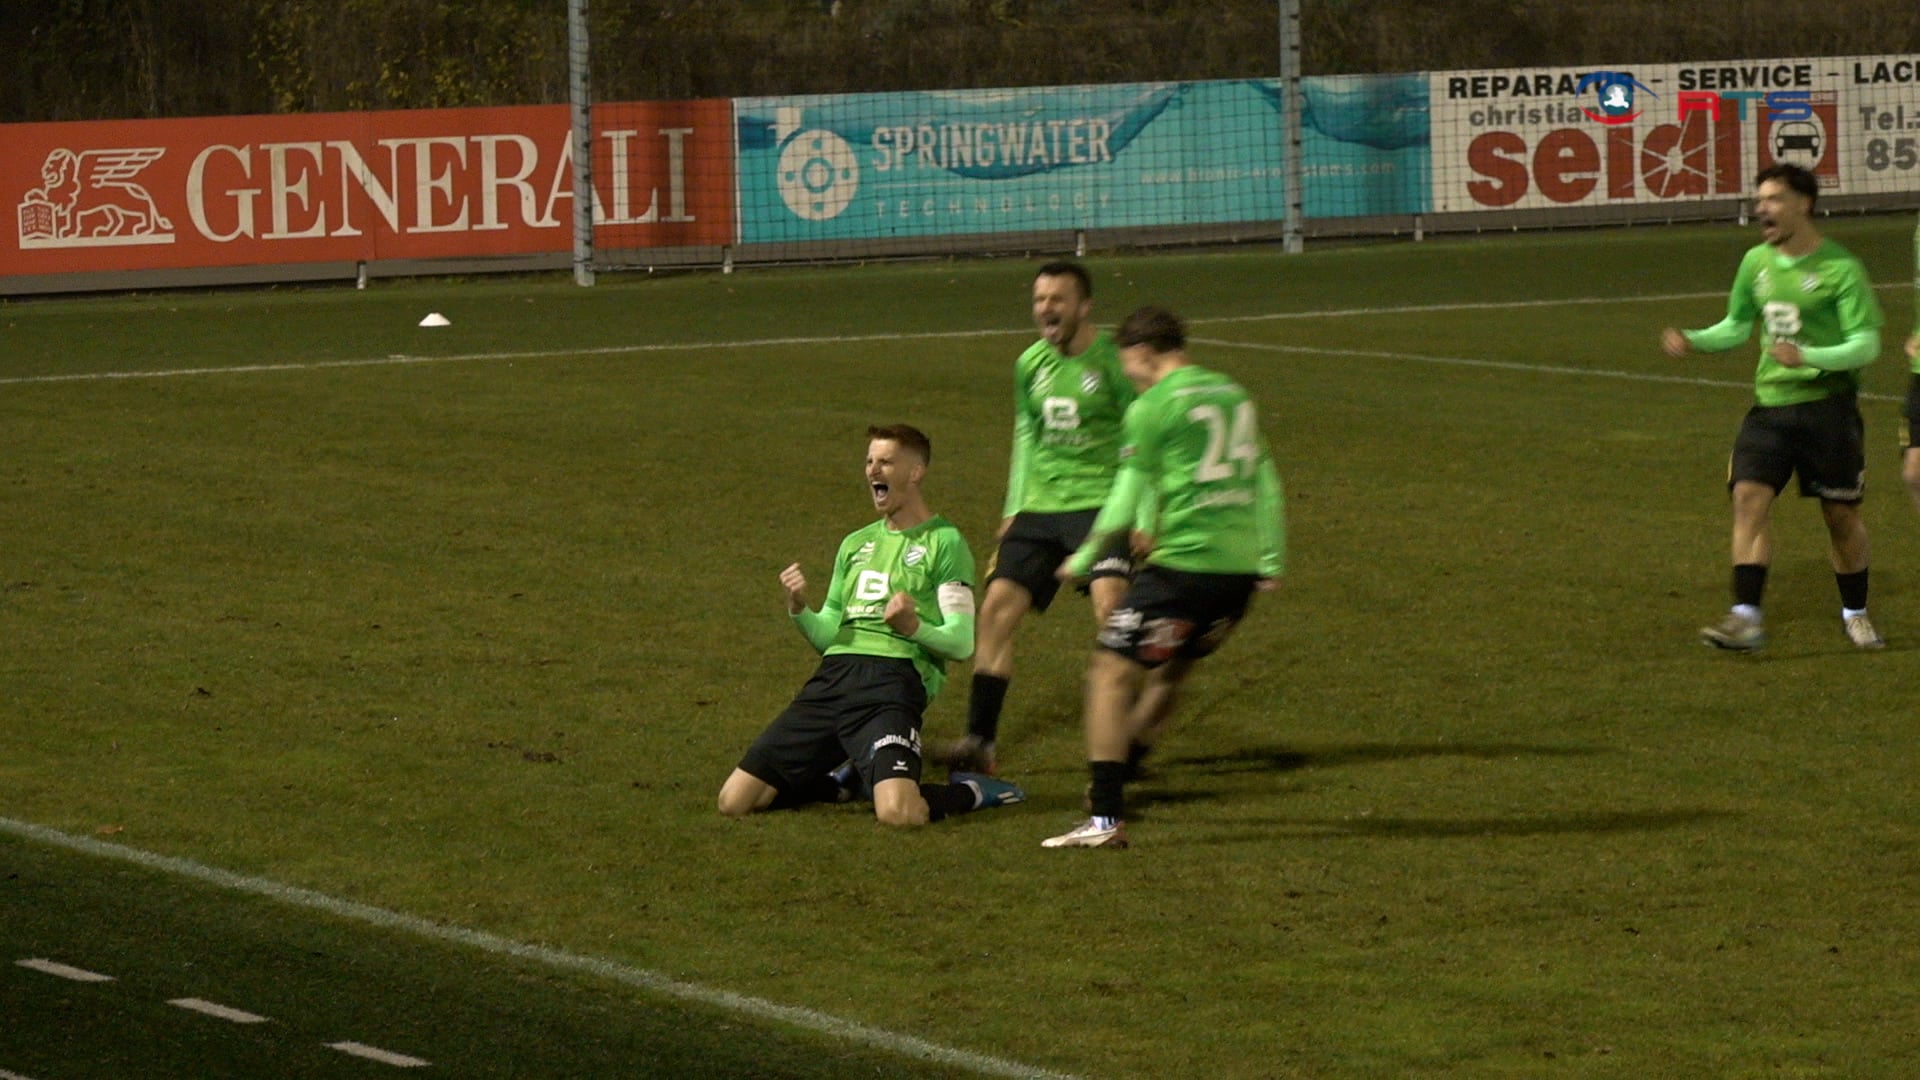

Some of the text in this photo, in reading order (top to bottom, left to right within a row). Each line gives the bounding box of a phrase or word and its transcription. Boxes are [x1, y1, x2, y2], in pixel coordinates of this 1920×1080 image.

[1449, 71, 1635, 99] REPARAT
[1677, 65, 1812, 90] SERVICE
[1854, 61, 1920, 85] LAC
[1469, 103, 1600, 127] christian
[872, 118, 1112, 172] SPRINGWATER
[1466, 98, 1742, 207] seidl
[1866, 138, 1918, 171] 85
[186, 127, 696, 243] GENERALI
[876, 193, 1110, 218] TECHNOLOGY
[1186, 399, 1260, 484] 24
